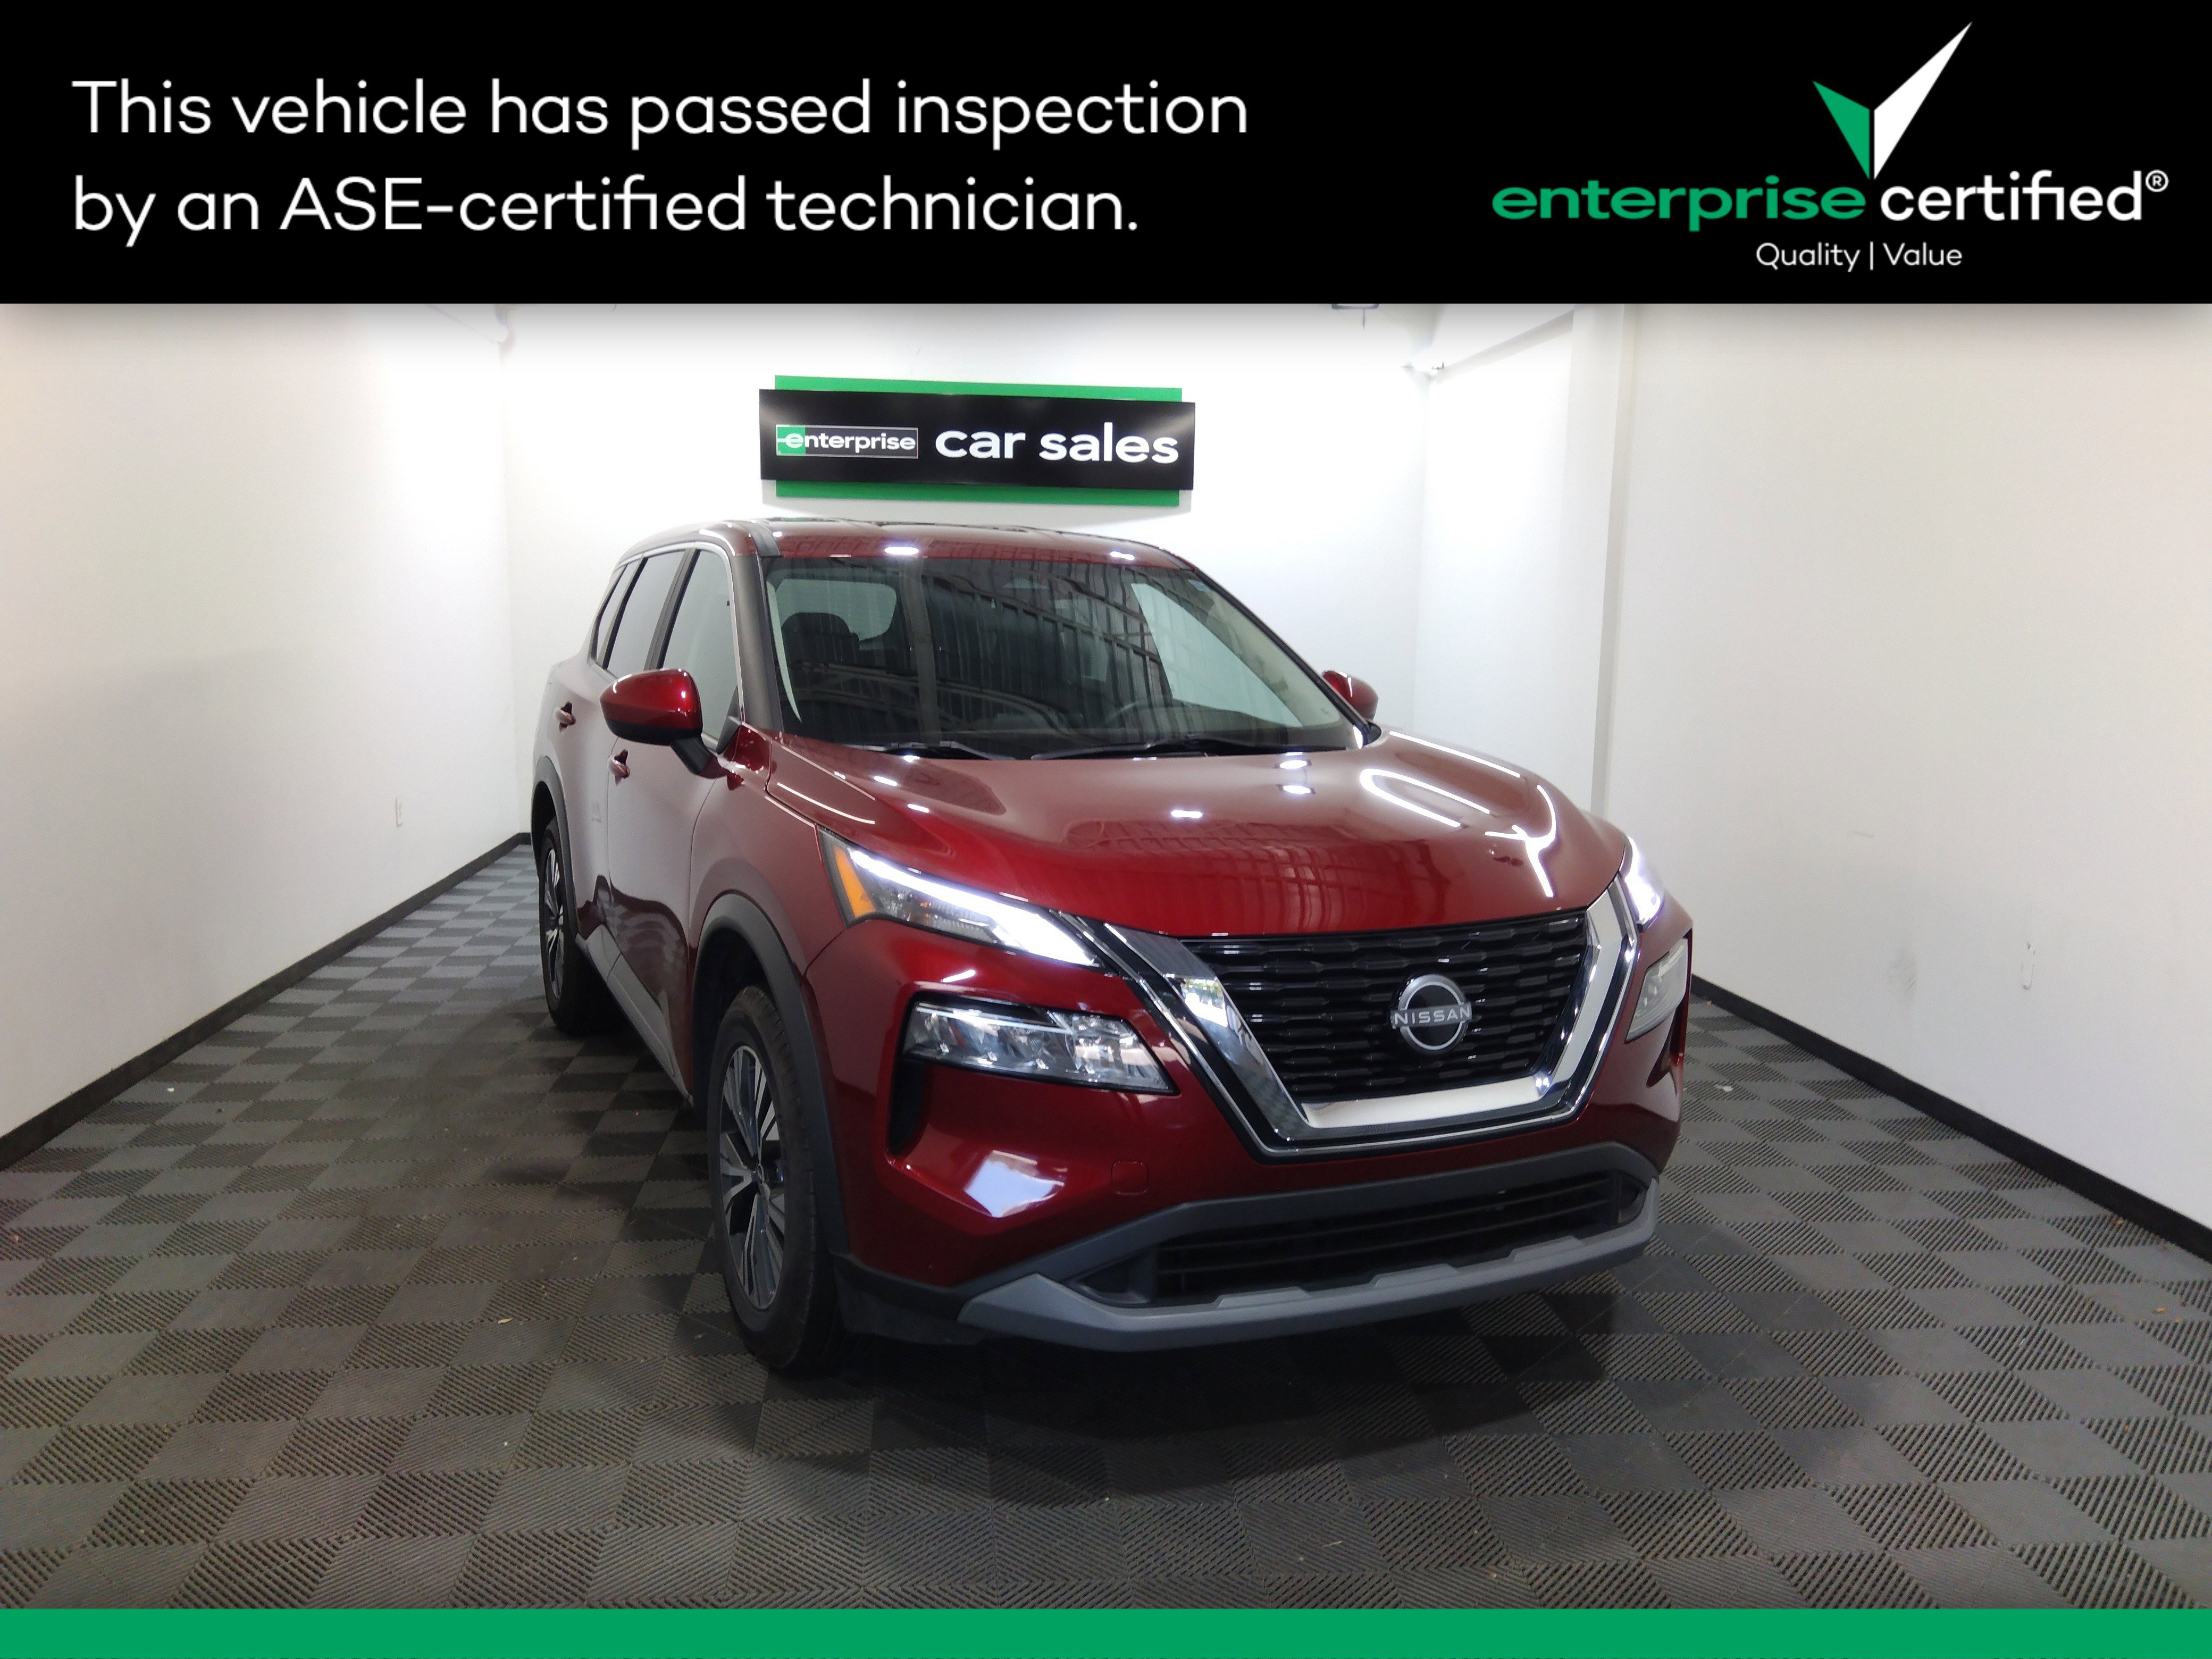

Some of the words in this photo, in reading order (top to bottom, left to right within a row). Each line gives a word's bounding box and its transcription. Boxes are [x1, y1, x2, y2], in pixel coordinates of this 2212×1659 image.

[784, 431, 916, 454] enterprise
[935, 429, 1026, 459] car
[1038, 422, 1179, 464] sales
[1394, 1006, 1471, 1025] NISSAN
